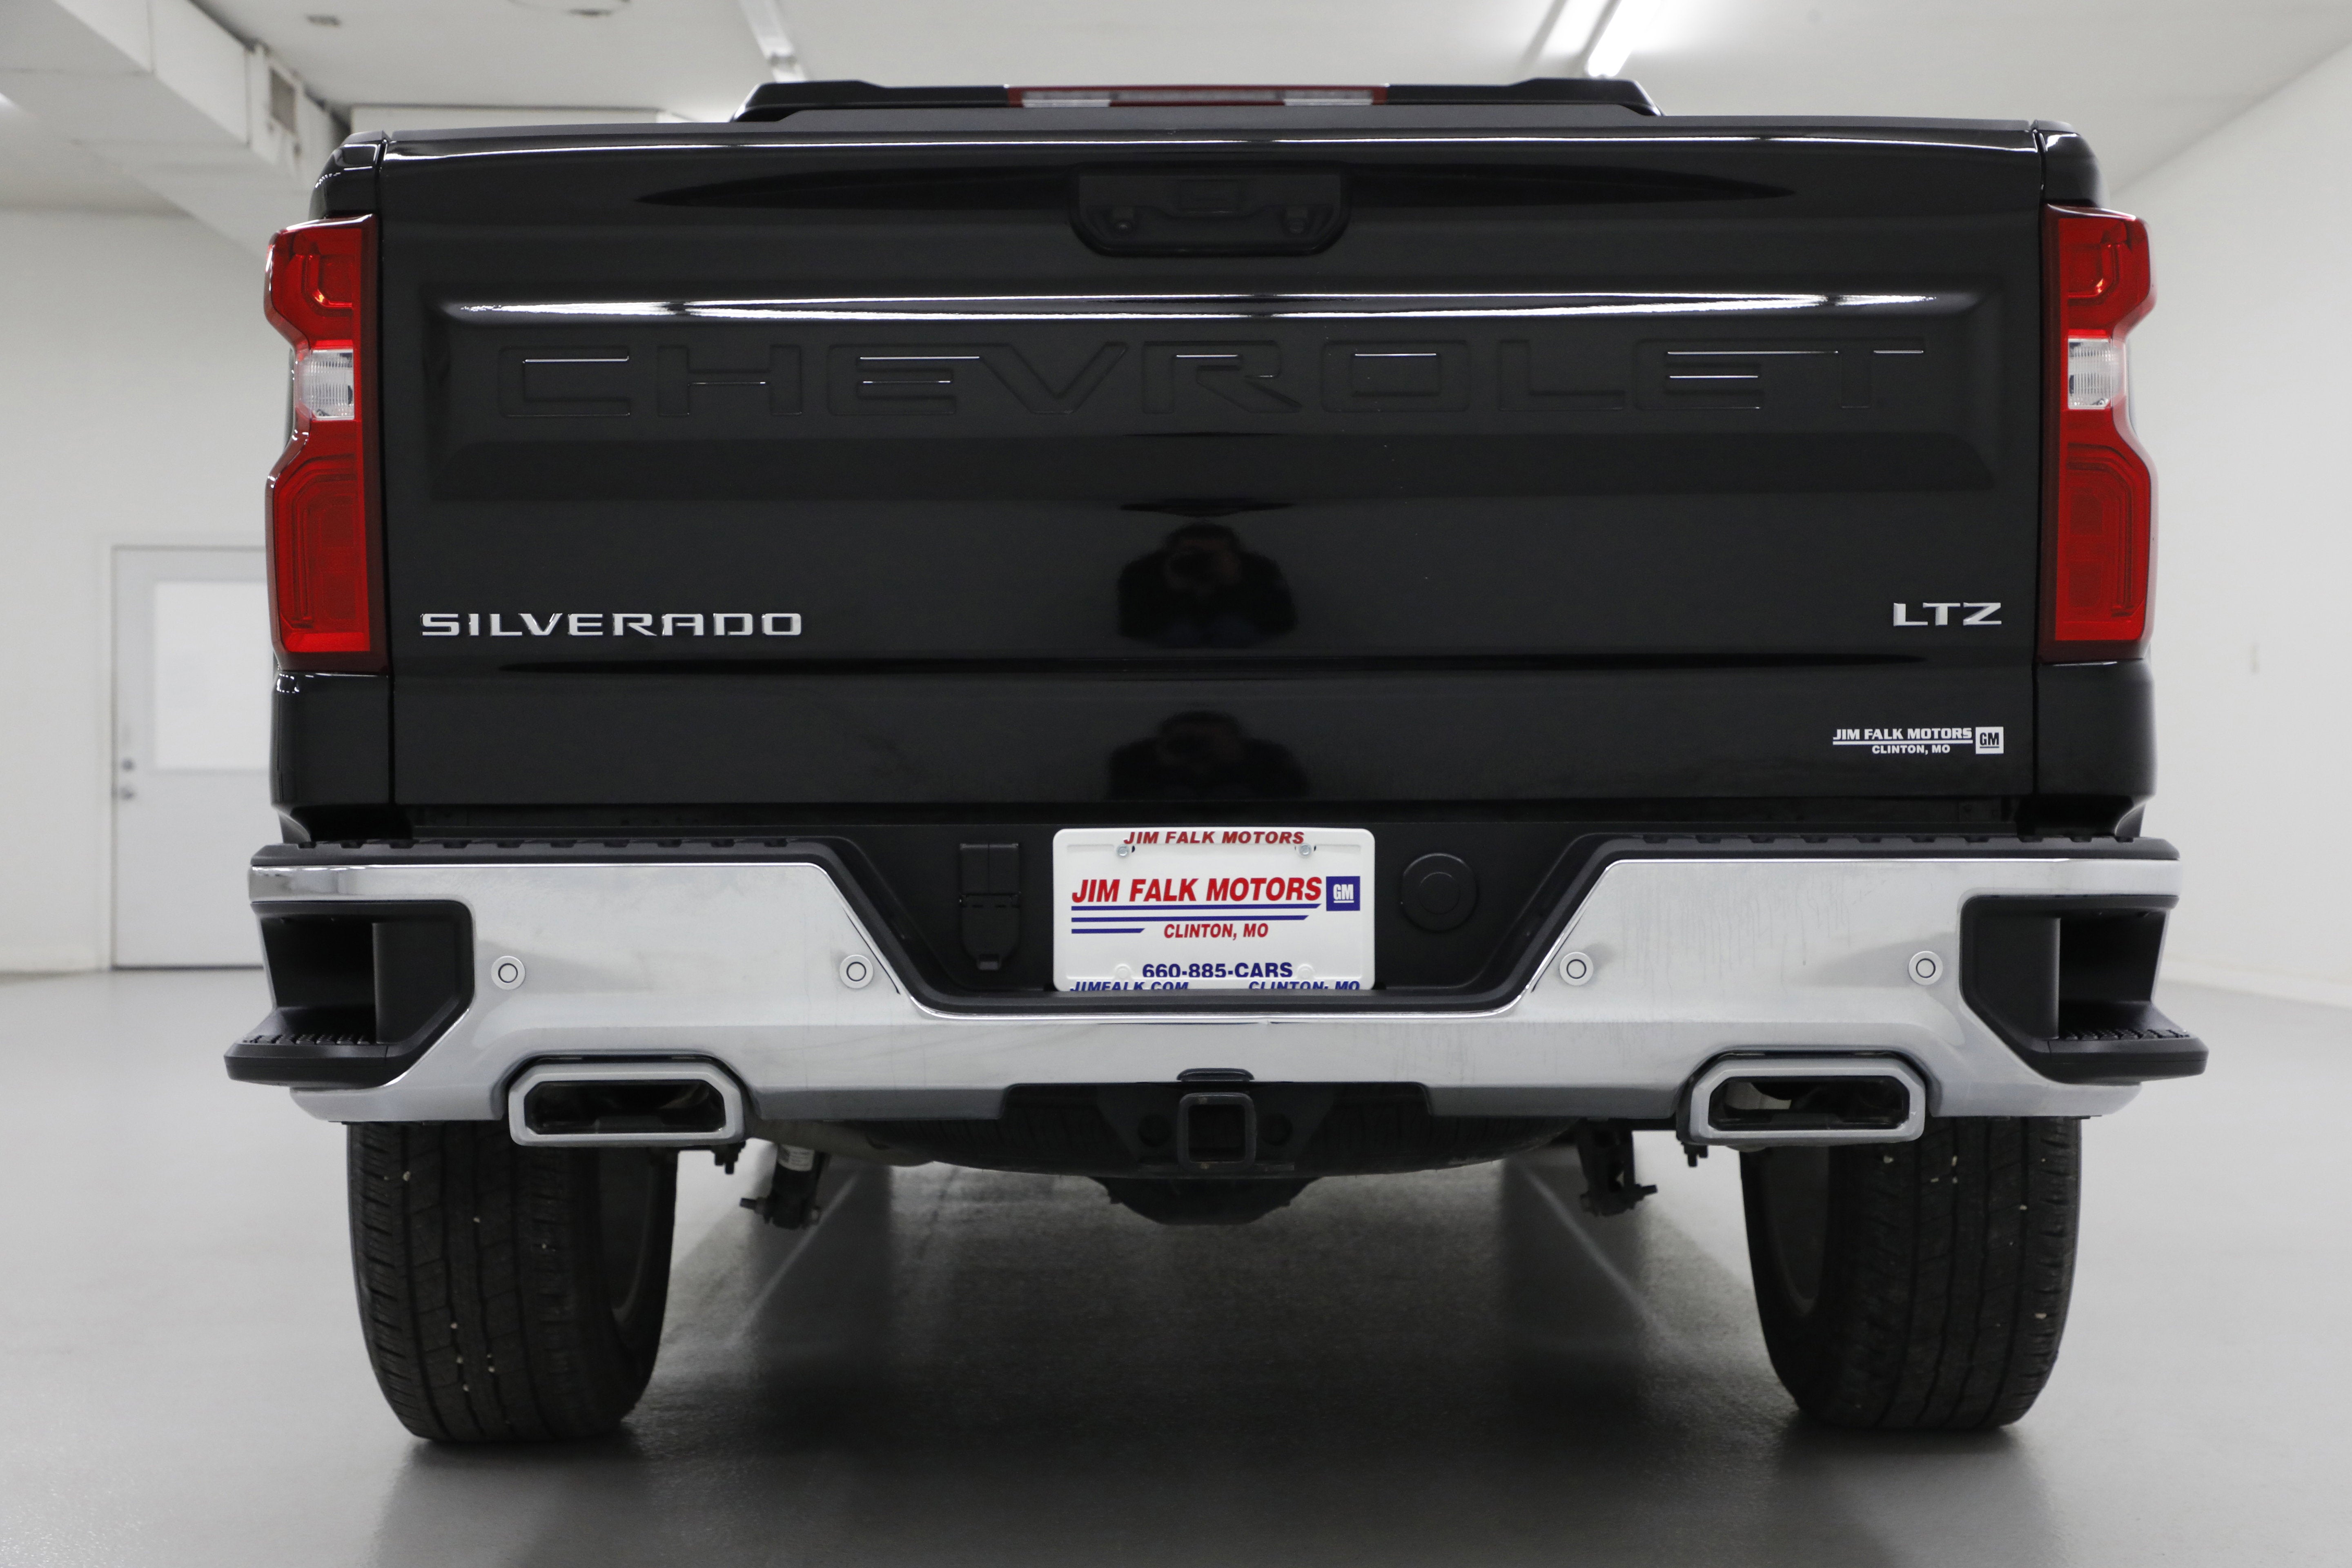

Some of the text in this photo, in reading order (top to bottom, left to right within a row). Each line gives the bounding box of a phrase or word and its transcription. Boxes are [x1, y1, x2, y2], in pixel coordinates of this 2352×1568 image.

[498, 338, 1925, 416] CHEVROLET
[1893, 602, 2002, 626] LTZ
[420, 613, 802, 636] SILVERADO
[1833, 728, 1972, 740] JIM FALK MOTORS
[1980, 733, 1999, 746] GM
[1872, 744, 1951, 755] CLINTON, MO
[1124, 831, 1304, 844] JIM FALK MOTORS
[1072, 877, 1322, 903] JIM FALK MOTORS
[1333, 884, 1354, 900] GM
[1164, 923, 1269, 940] CLINTON, MO
[1143, 962, 1293, 978] 660-885-CARS
[1070, 981, 1189, 991] JIMFALKCOM
[1335, 981, 1361, 990] MO
